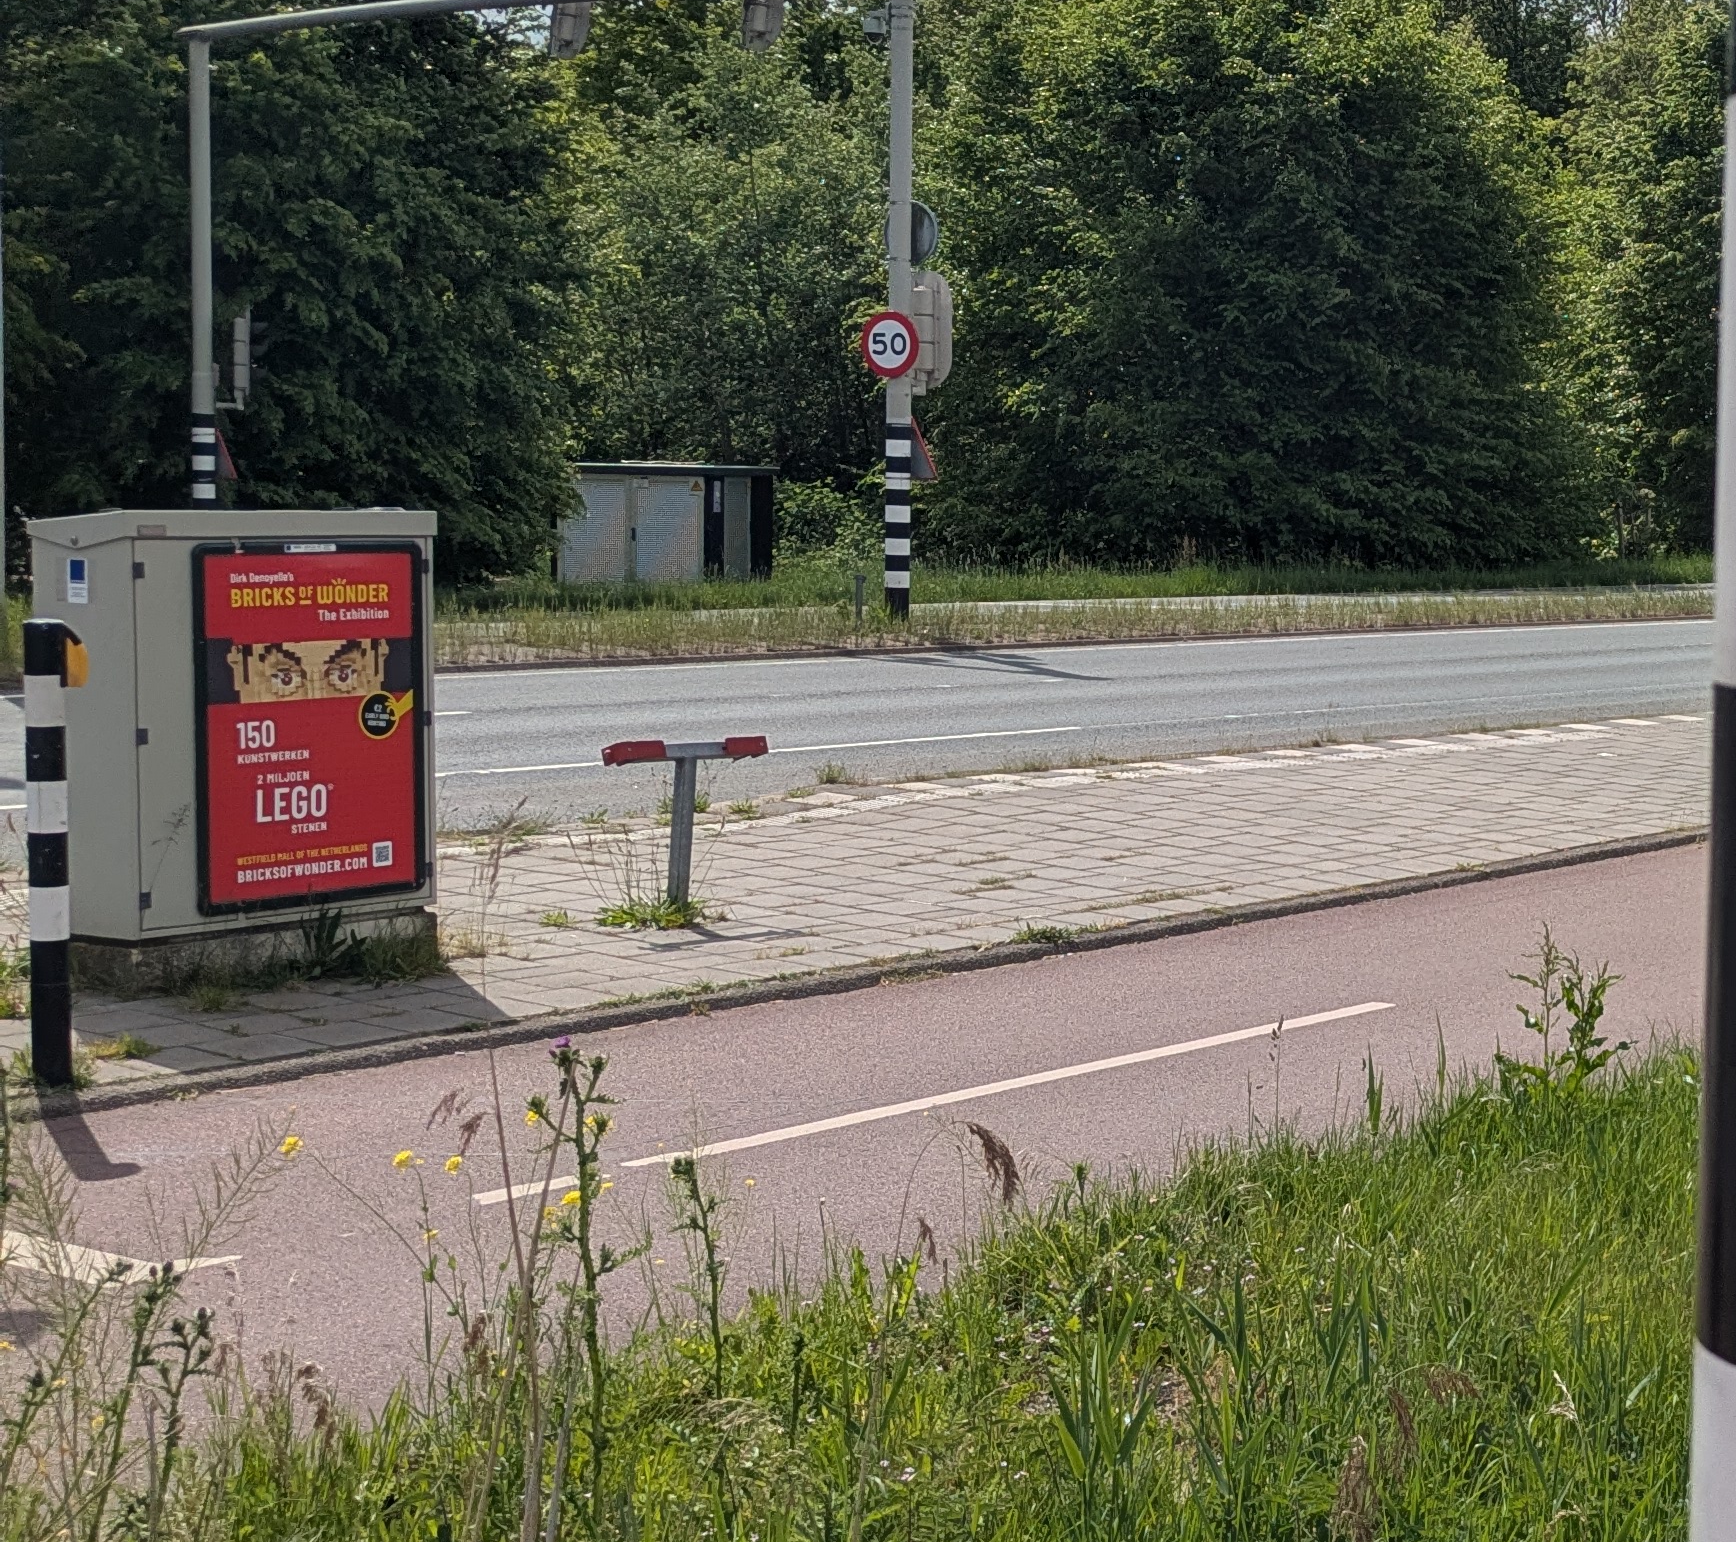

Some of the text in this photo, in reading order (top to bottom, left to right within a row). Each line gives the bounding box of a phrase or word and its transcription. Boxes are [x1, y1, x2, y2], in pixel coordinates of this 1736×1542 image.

[872, 332, 907, 356] 50
[230, 573, 248, 584] Dirk
[230, 583, 389, 608] BRICKS OF WONDER
[318, 607, 390, 621] The Exhibition
[236, 719, 276, 749] 150
[237, 749, 310, 765] KUNSTWERKEN
[257, 770, 310, 785] 2 MILJOEN
[256, 783, 327, 823] LEGO
[291, 821, 328, 834] STENEN
[237, 853, 276, 866] WESTFIELD
[296, 850, 305, 859] OF
[306, 848, 320, 858] THE
[321, 843, 368, 856] NETHERLANDS
[237, 856, 368, 884] BRICKSOFWONDER.COM
